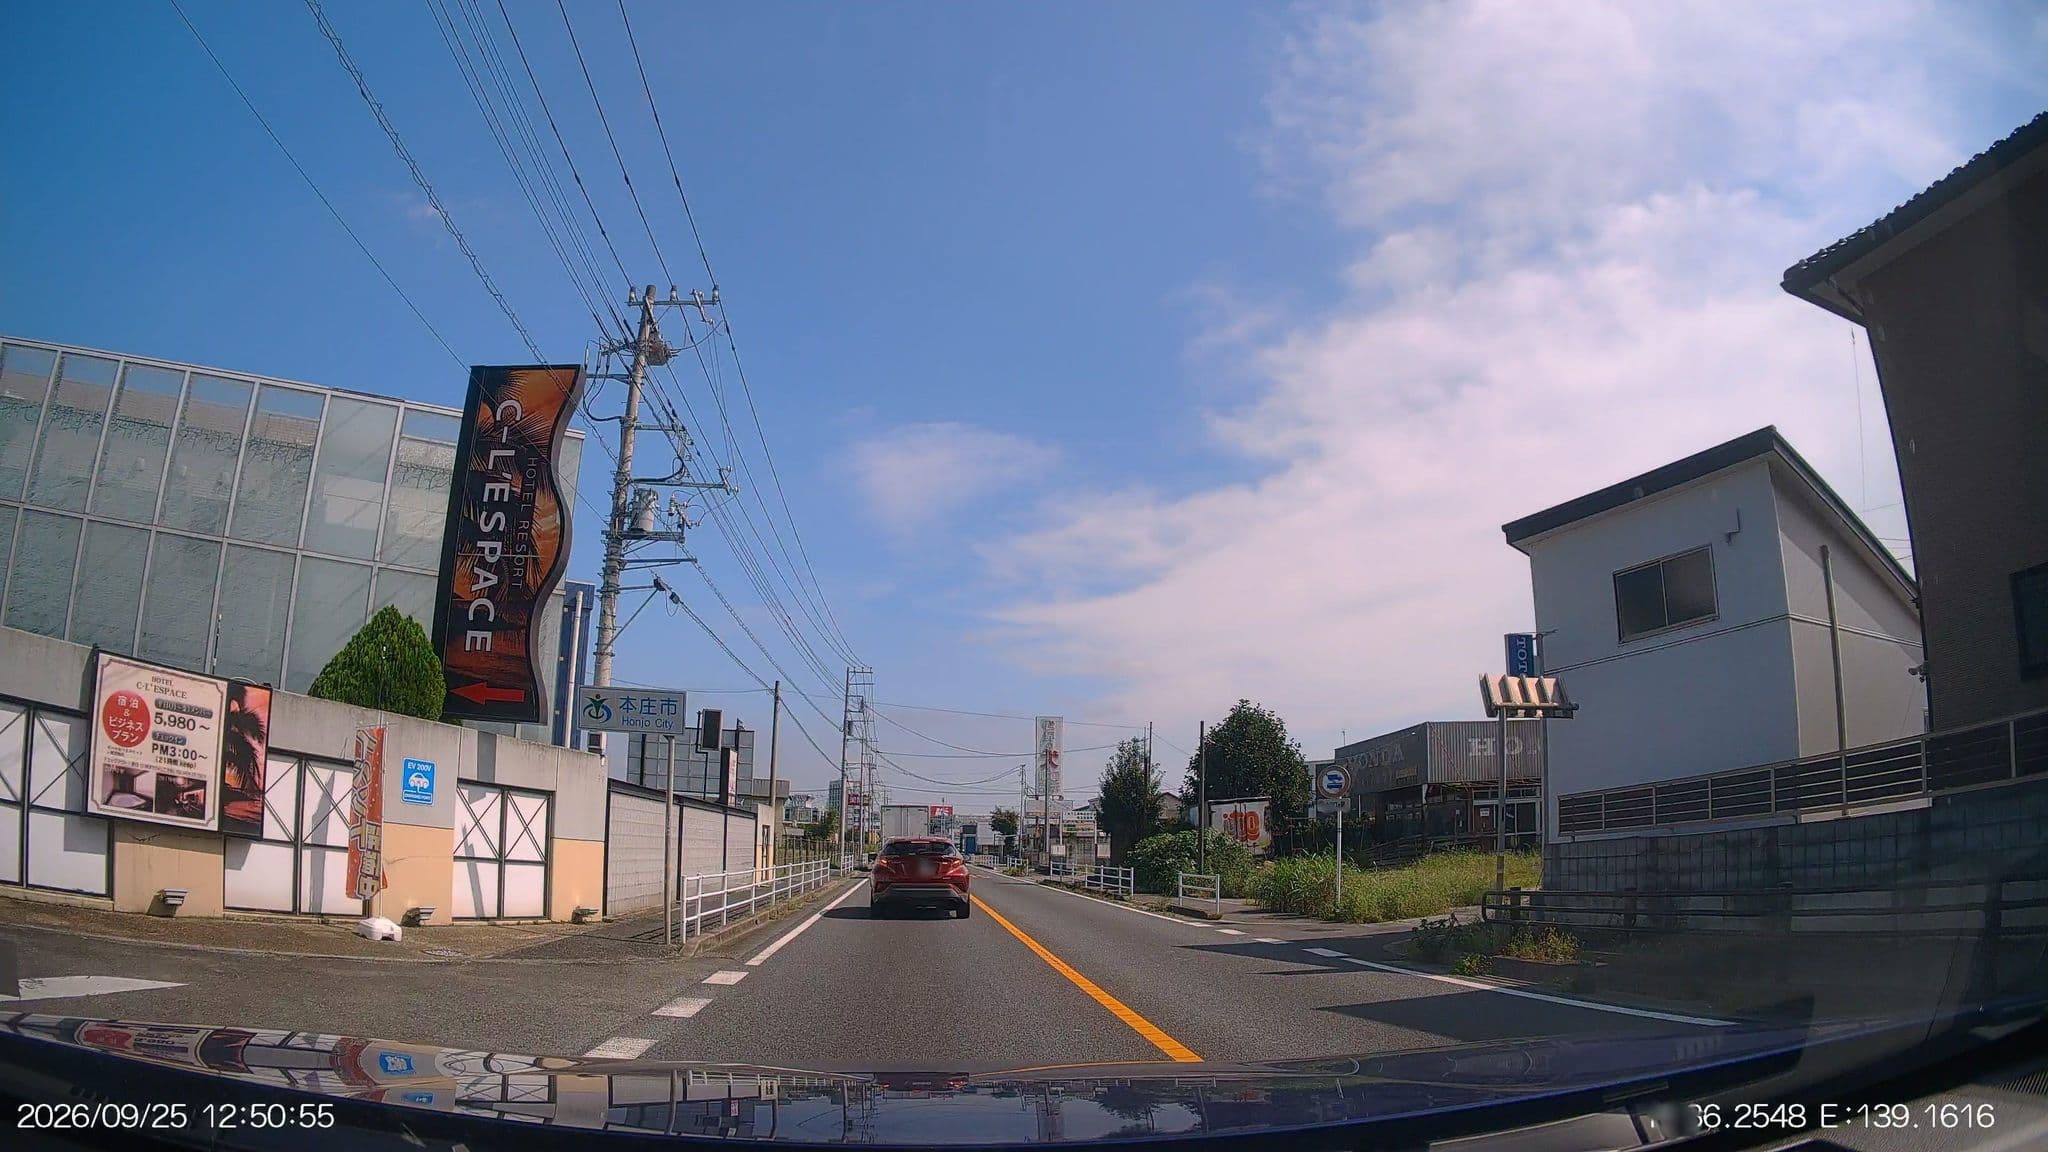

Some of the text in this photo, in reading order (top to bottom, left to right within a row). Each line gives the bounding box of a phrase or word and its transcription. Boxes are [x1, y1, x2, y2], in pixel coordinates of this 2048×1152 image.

[464, 400, 522, 652] C-L'ESPACE
[511, 456, 538, 589] HOTEL RESORT
[1516, 636, 1528, 676] TOT
[151, 675, 174, 686] HOTEL
[619, 695, 679, 716] 本庄市
[108, 715, 144, 733] ビジネス
[621, 716, 674, 730] Honjo City
[112, 730, 139, 743] プラン
[407, 761, 416, 770] EV
